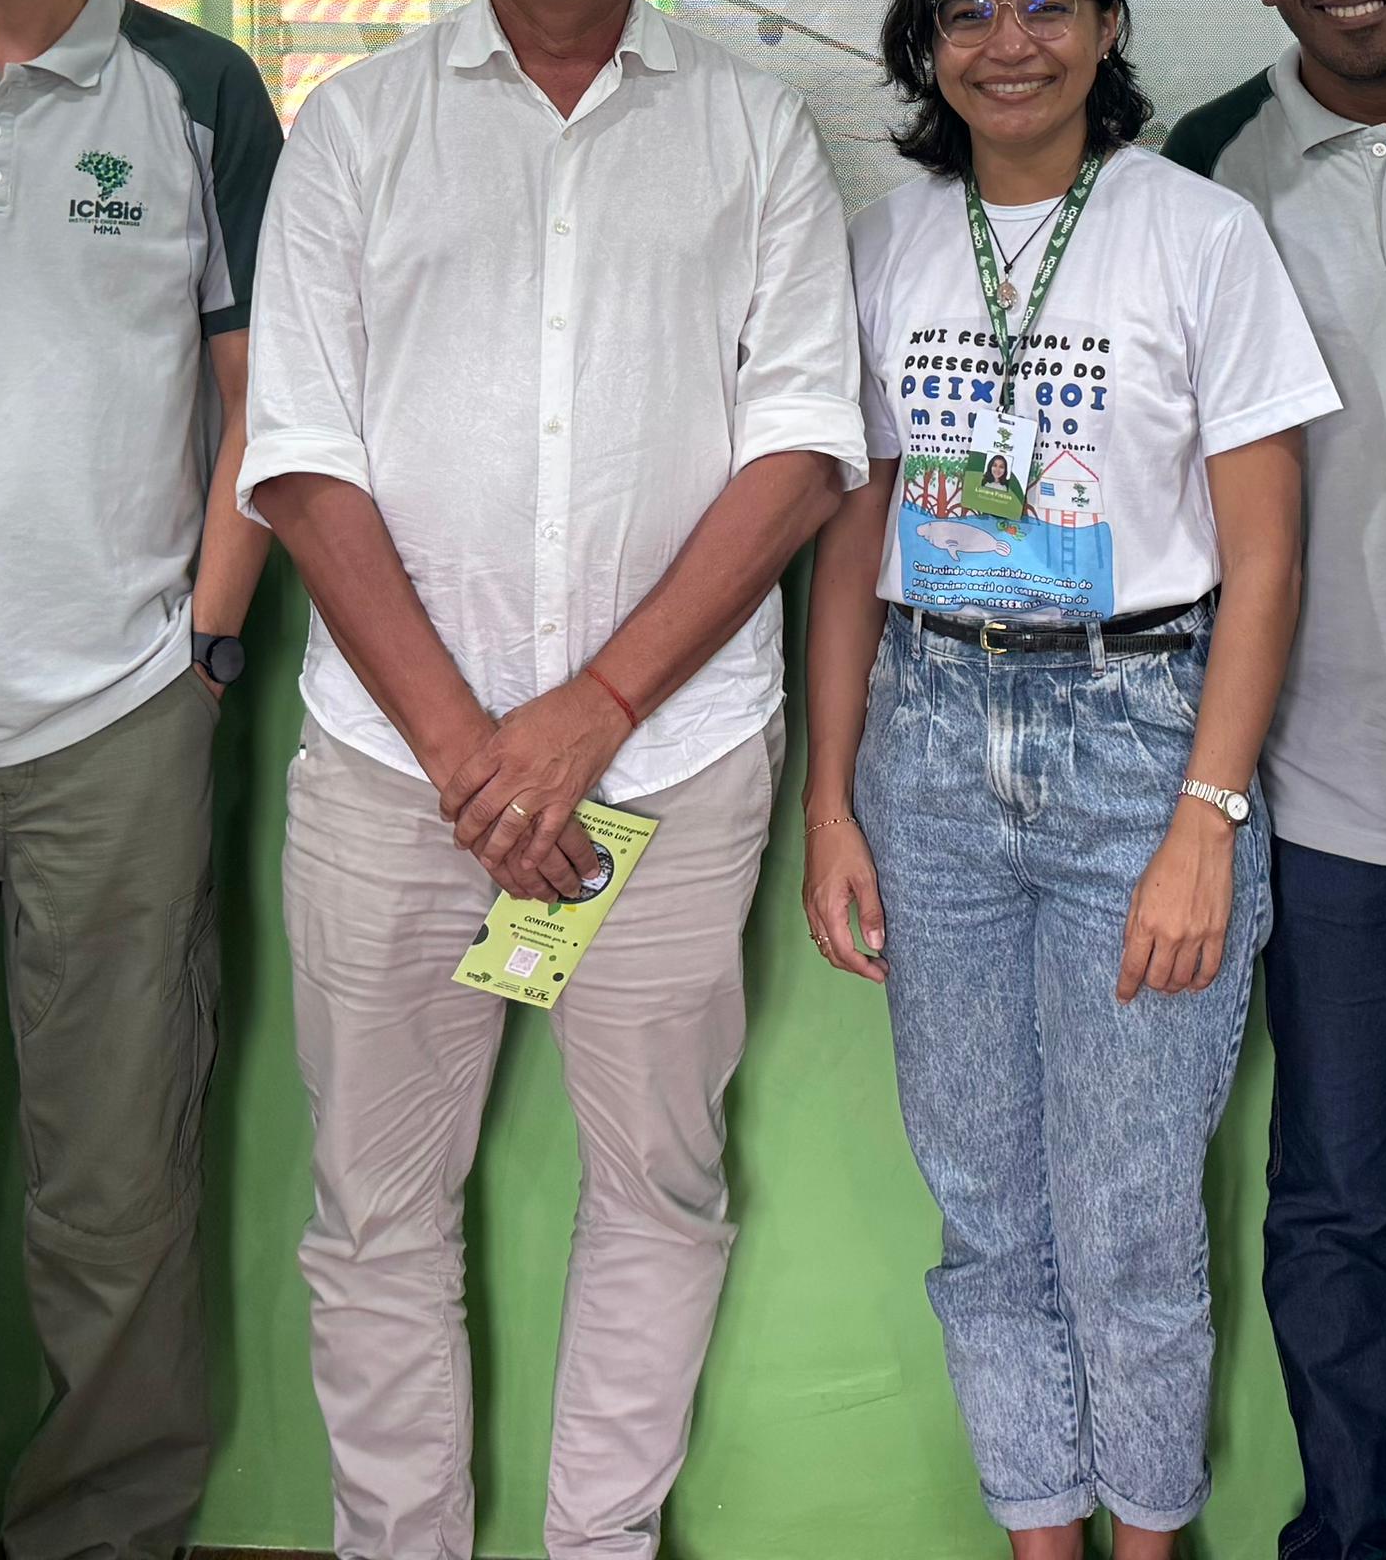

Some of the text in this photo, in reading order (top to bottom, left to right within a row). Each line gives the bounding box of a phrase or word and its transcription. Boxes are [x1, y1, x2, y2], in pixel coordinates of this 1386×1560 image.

[69, 199, 143, 221] ICMBio
[93, 225, 121, 235] MMA
[910, 329, 947, 344] XVI
[958, 331, 1071, 350] FESTIVAL
[1082, 337, 1110, 353] DE
[904, 355, 1106, 380] PRESERVAÇÃO DO
[1036, 382, 1107, 411] BOI
[1033, 574, 1053, 585] por
[1054, 577, 1077, 589] meio
[1078, 579, 1093, 590] do
[524, 915, 565, 932] CONTATOS
